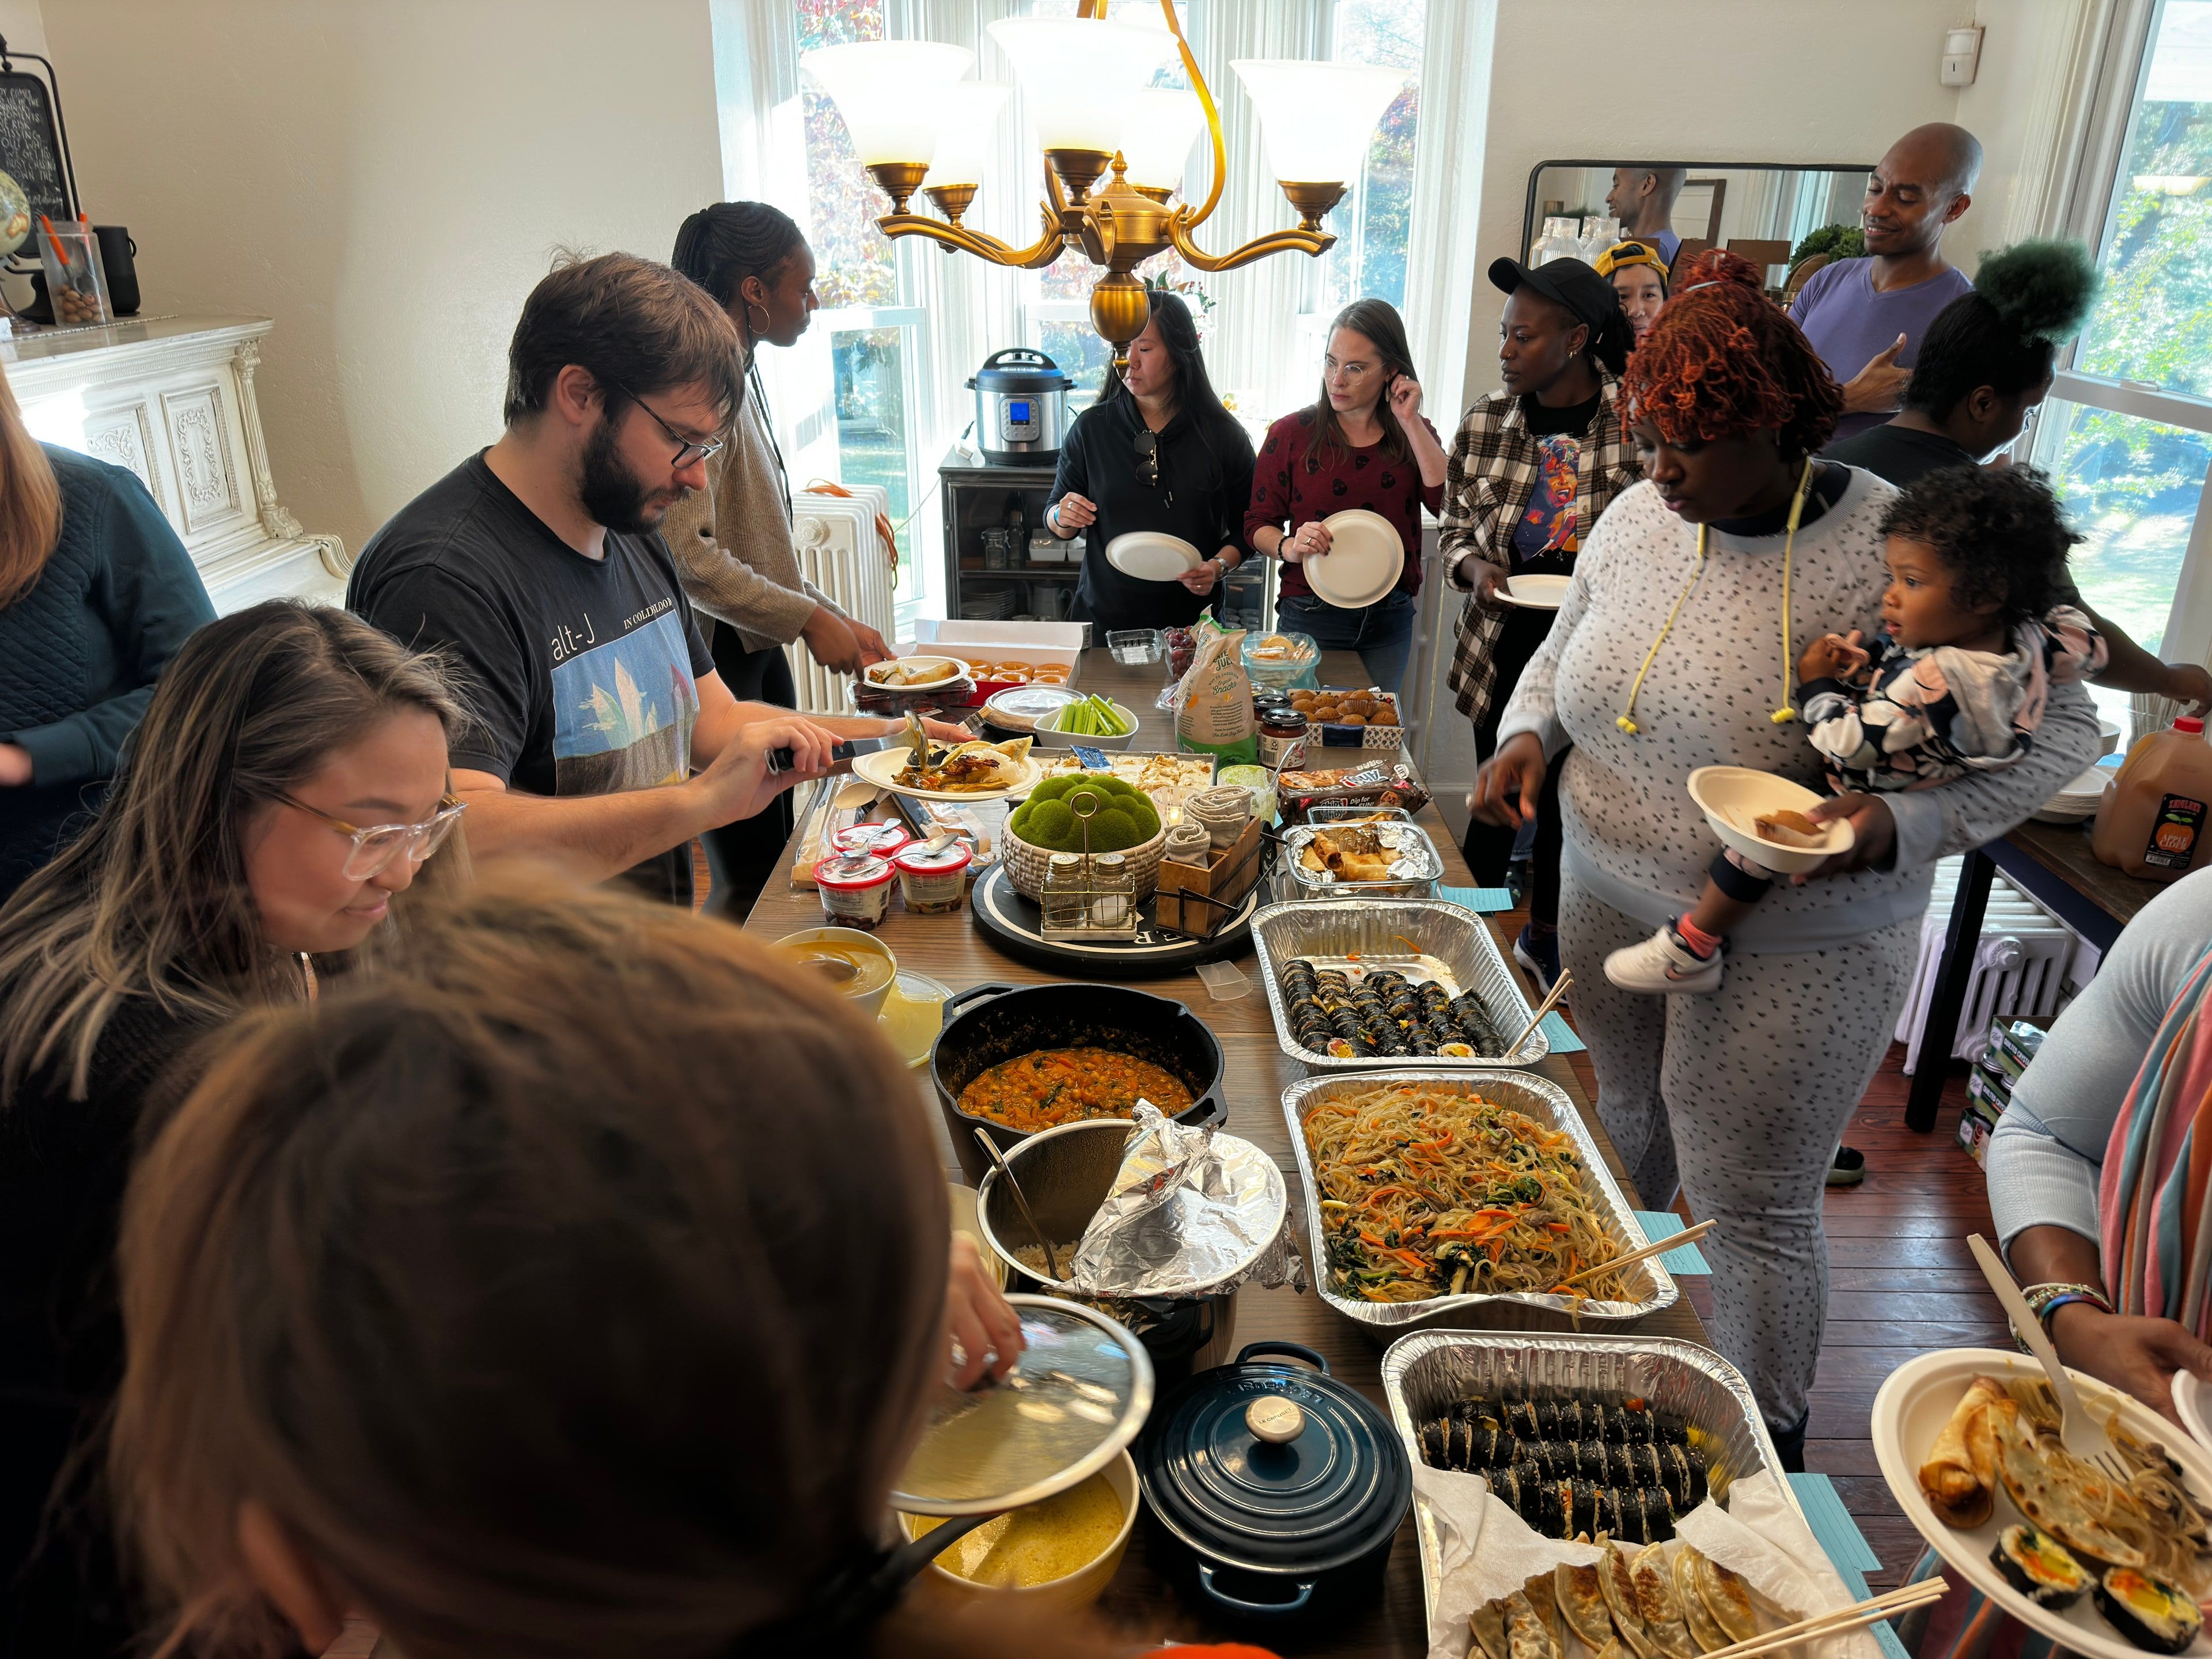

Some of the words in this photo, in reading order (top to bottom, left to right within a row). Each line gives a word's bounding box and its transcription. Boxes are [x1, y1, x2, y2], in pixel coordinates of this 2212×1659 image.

[12, 119, 31, 130] RISK
[1, 137, 21, 150] OUT
[40, 170, 55, 183] THE
[623, 617, 632, 630] IN
[632, 607, 654, 624] COLD
[551, 612, 595, 661] alt-J
[1208, 677, 1216, 685] WHY
[1213, 681, 1237, 695] Snacks
[2160, 840, 2188, 850] CIDER
[2161, 834, 2188, 843] APPLE
[2003, 1037, 2018, 1055] QUILTED
[1983, 1085, 1997, 1102] QUILTED
[1266, 1407, 1291, 1422] CREUSET
